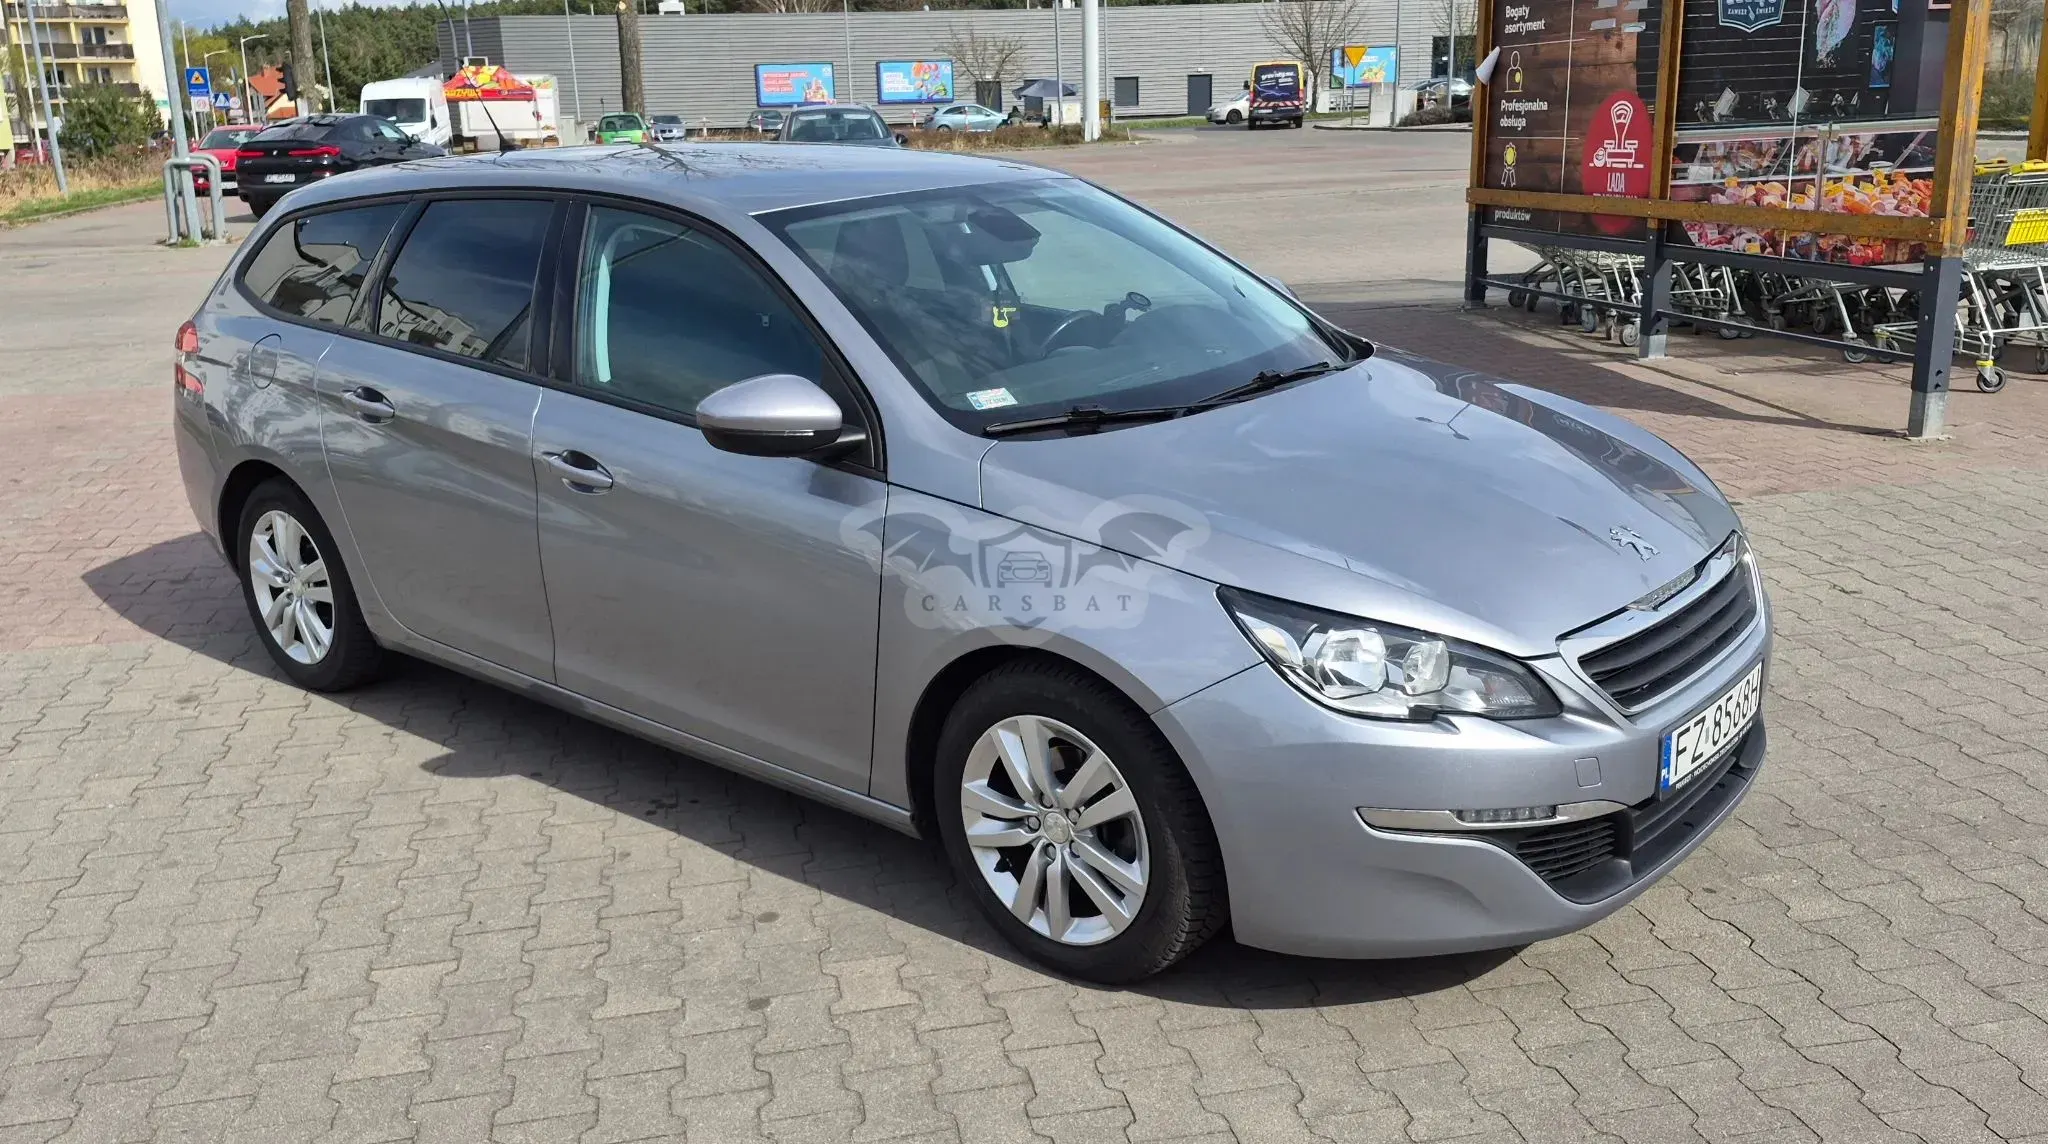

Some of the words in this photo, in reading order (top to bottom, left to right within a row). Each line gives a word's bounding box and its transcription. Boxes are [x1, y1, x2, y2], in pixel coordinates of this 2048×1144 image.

[1505, 4, 1530, 21] Bogaty
[1504, 18, 1546, 35] asortyment
[1500, 98, 1548, 115] Profesjonalna
[1499, 114, 1527, 131] obsługa
[1606, 172, 1625, 192] LADA
[1494, 207, 1531, 222] produktów
[1674, 714, 1707, 777] FZ
[1712, 667, 1760, 747] 8568H
[1660, 766, 1670, 782] PL
